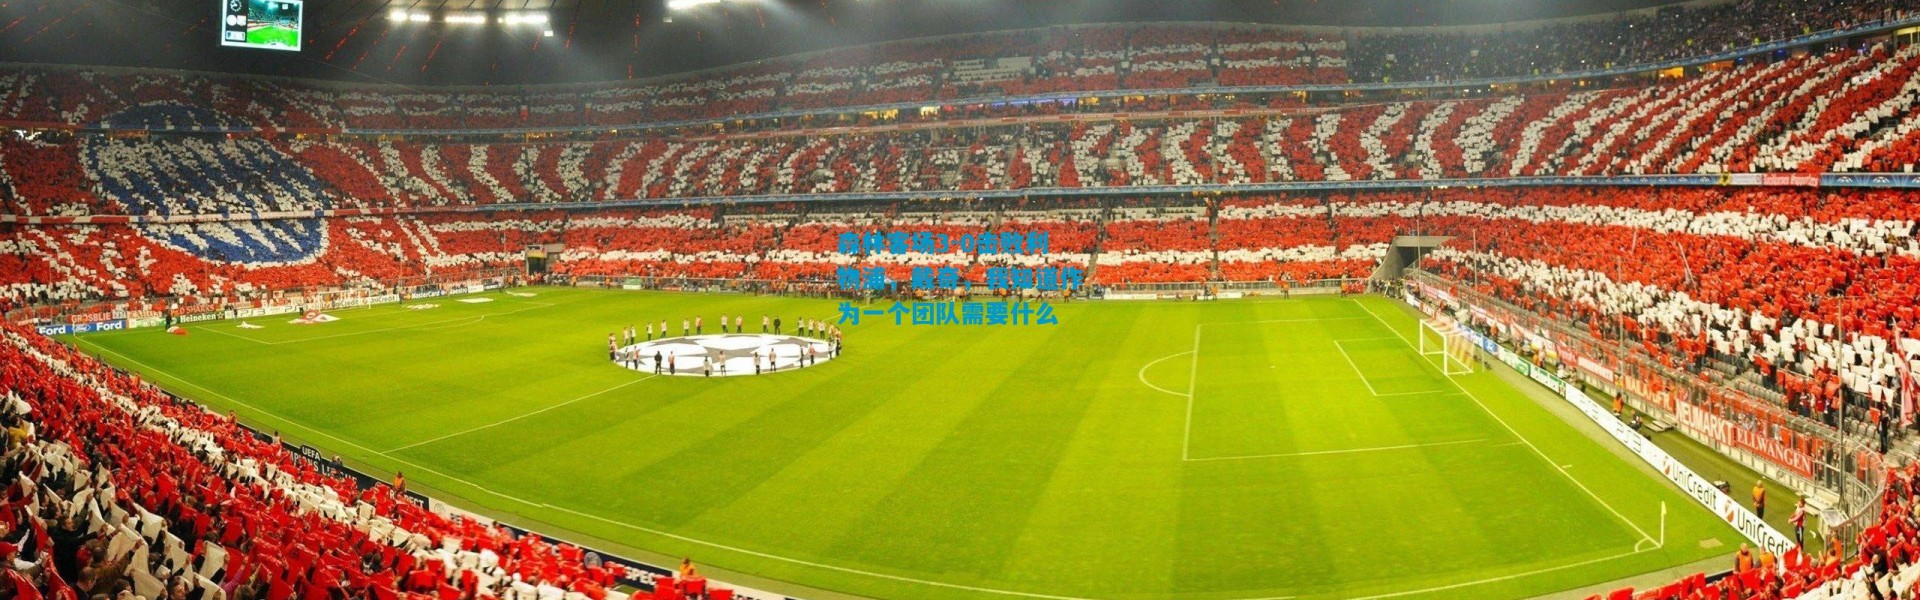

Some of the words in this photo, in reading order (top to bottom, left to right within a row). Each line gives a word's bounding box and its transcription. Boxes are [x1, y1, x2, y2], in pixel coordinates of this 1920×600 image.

[180, 312, 217, 323] Heineken
[38, 325, 66, 335] Ford
[96, 321, 123, 331] Ford
[1676, 400, 1735, 446] NEUMARKT
[301, 446, 321, 461] UEFA
[1737, 427, 1813, 475] ELLWANGEN
[1672, 463, 1717, 514] UniCredit
